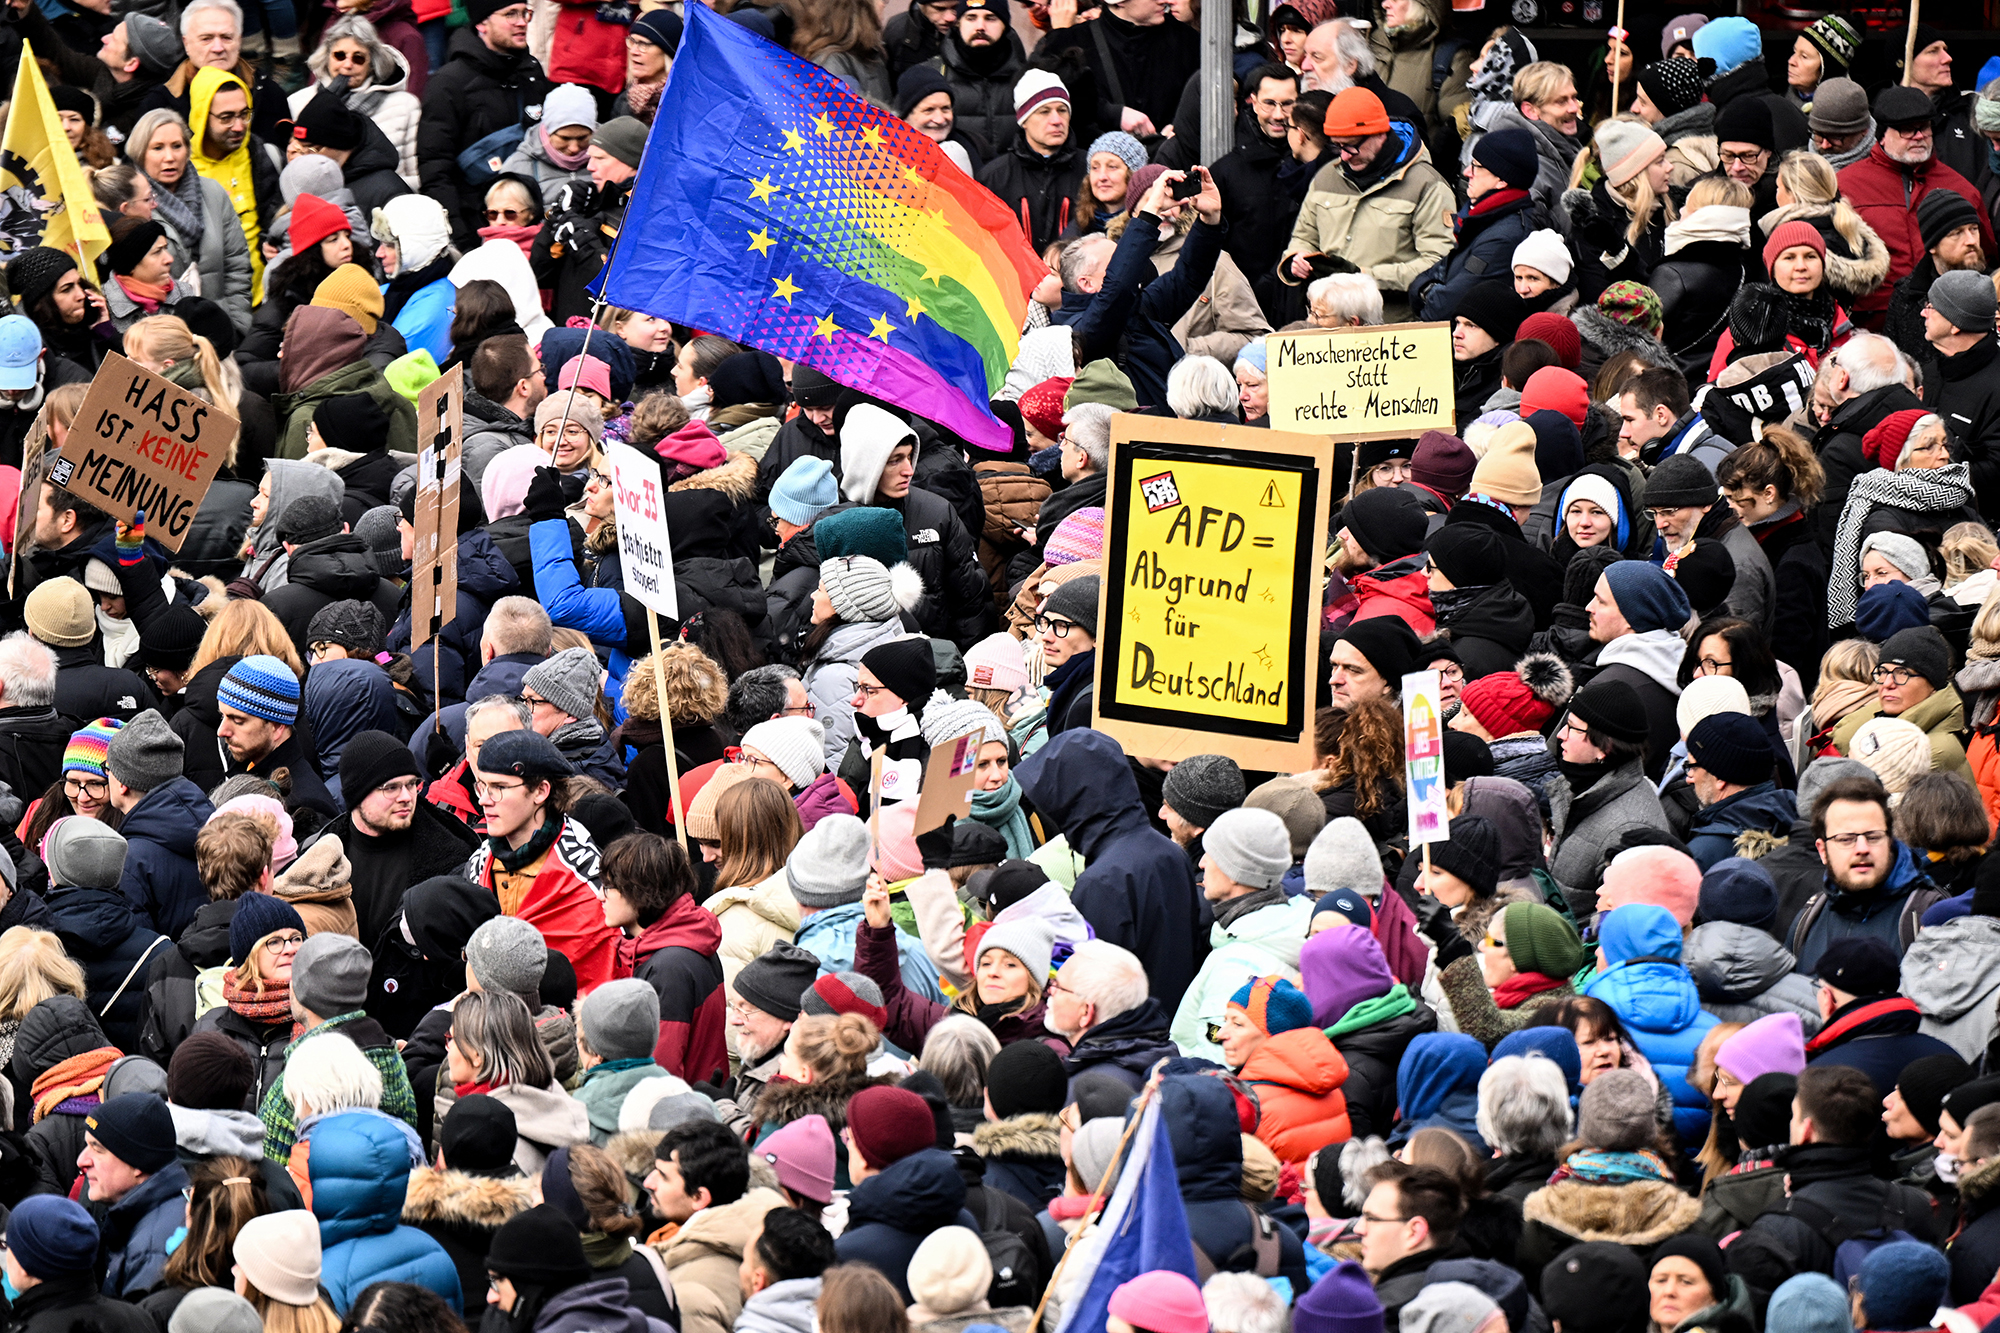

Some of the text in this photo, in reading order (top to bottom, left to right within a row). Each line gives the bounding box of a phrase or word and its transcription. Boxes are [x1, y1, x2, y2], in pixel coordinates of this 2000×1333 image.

[1278, 336, 1417, 367] Menschenrechte
[1346, 363, 1388, 388] statt
[125, 375, 208, 443] HASS
[1295, 387, 1438, 421] rechte Menschen
[95, 409, 209, 482] IST KEINE
[76, 448, 194, 537] MEINUNG
[624, 486, 641, 514] vor
[642, 479, 658, 522] 33
[1142, 476, 1175, 497] FCK
[1149, 489, 1178, 508] AFD
[1165, 505, 1245, 552] AFD
[1131, 550, 1252, 605] Abgrund
[1165, 607, 1200, 638] für
[1131, 641, 1284, 707] Deutschland
